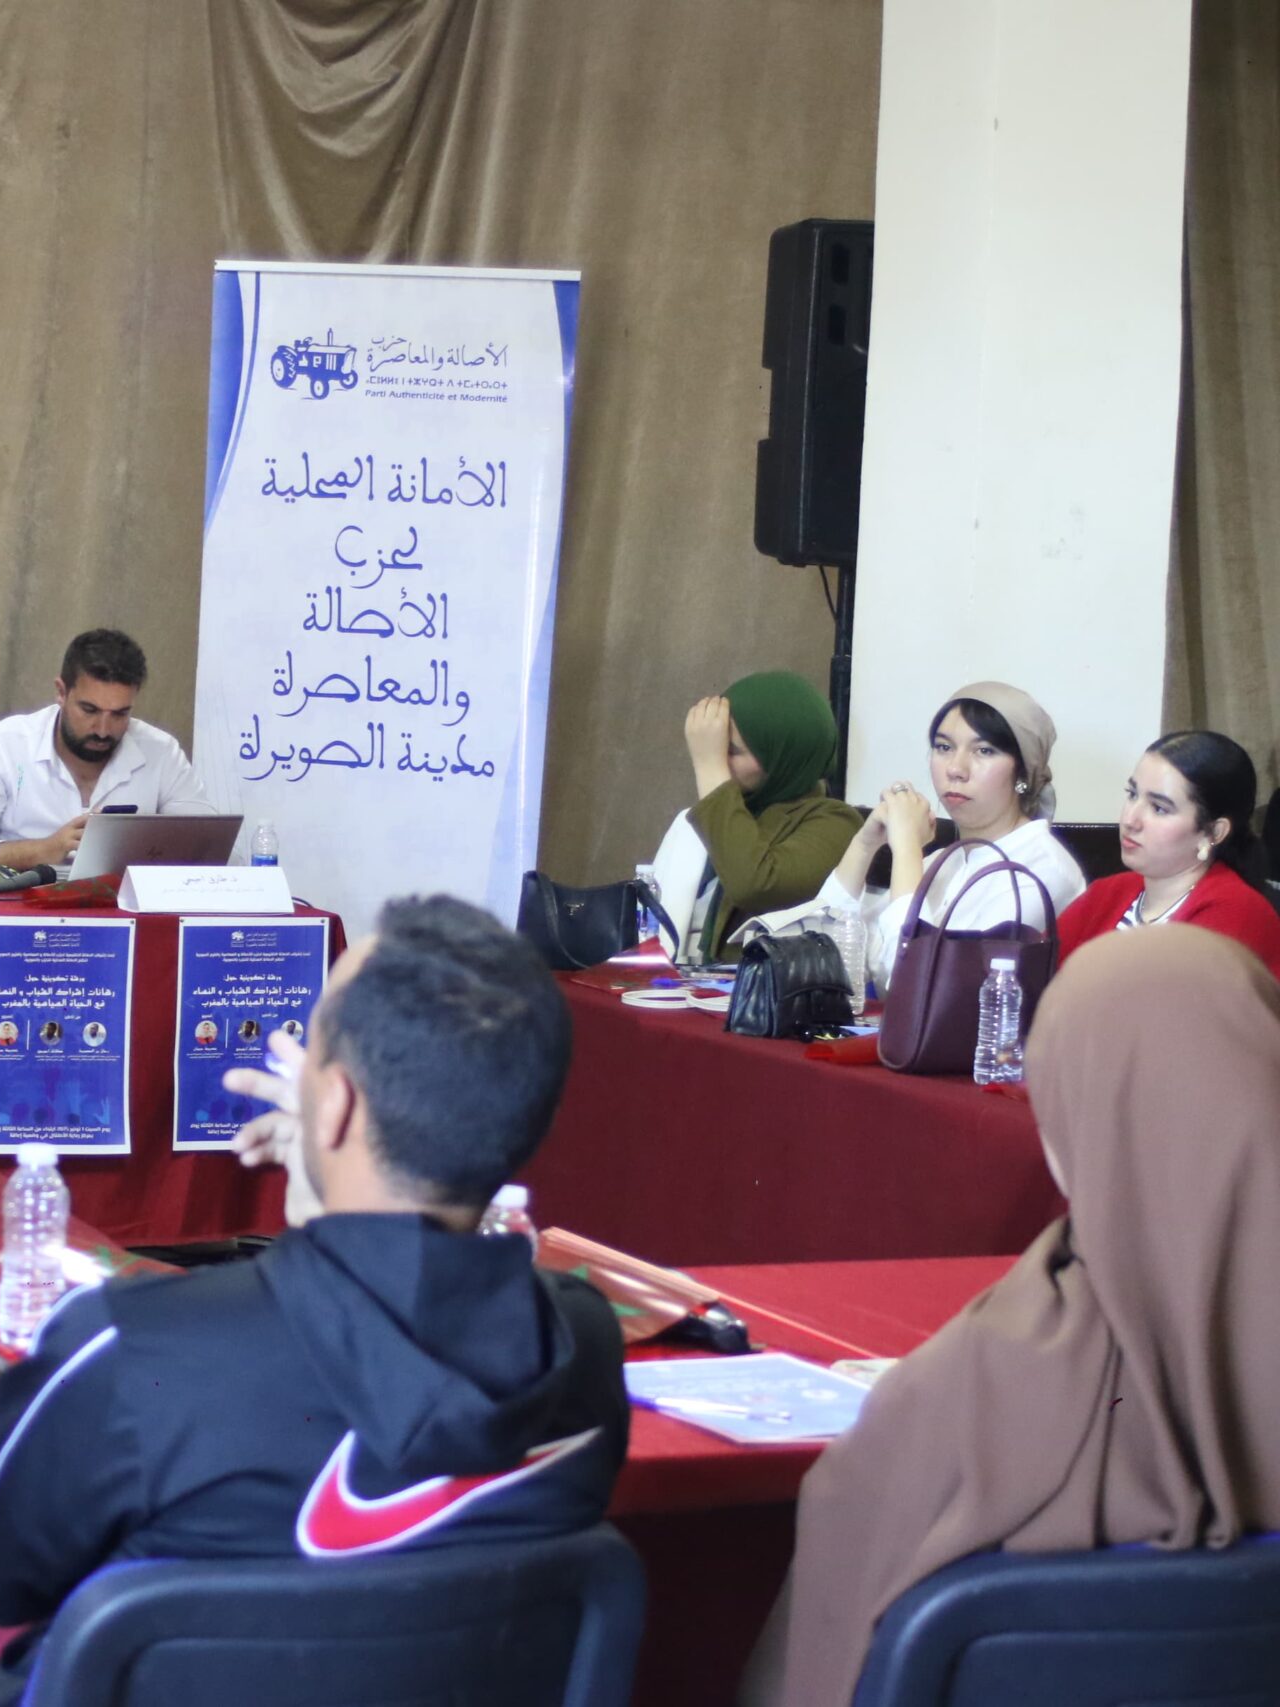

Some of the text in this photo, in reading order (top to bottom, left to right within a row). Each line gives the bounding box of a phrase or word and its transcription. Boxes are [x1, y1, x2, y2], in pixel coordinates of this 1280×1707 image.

[371, 336, 407, 352] حزب
[447, 342, 508, 368] الأصالة
[365, 390, 386, 398] Parti
[389, 391, 445, 400] Authenticité
[460, 393, 507, 403] Modernité
[261, 451, 507, 508] الأمانة المحلية
[335, 525, 423, 589] لحزب
[303, 585, 449, 638] الأصالة
[273, 650, 470, 727] والمعاصرة
[239, 714, 495, 782] مدينة الصويرة
